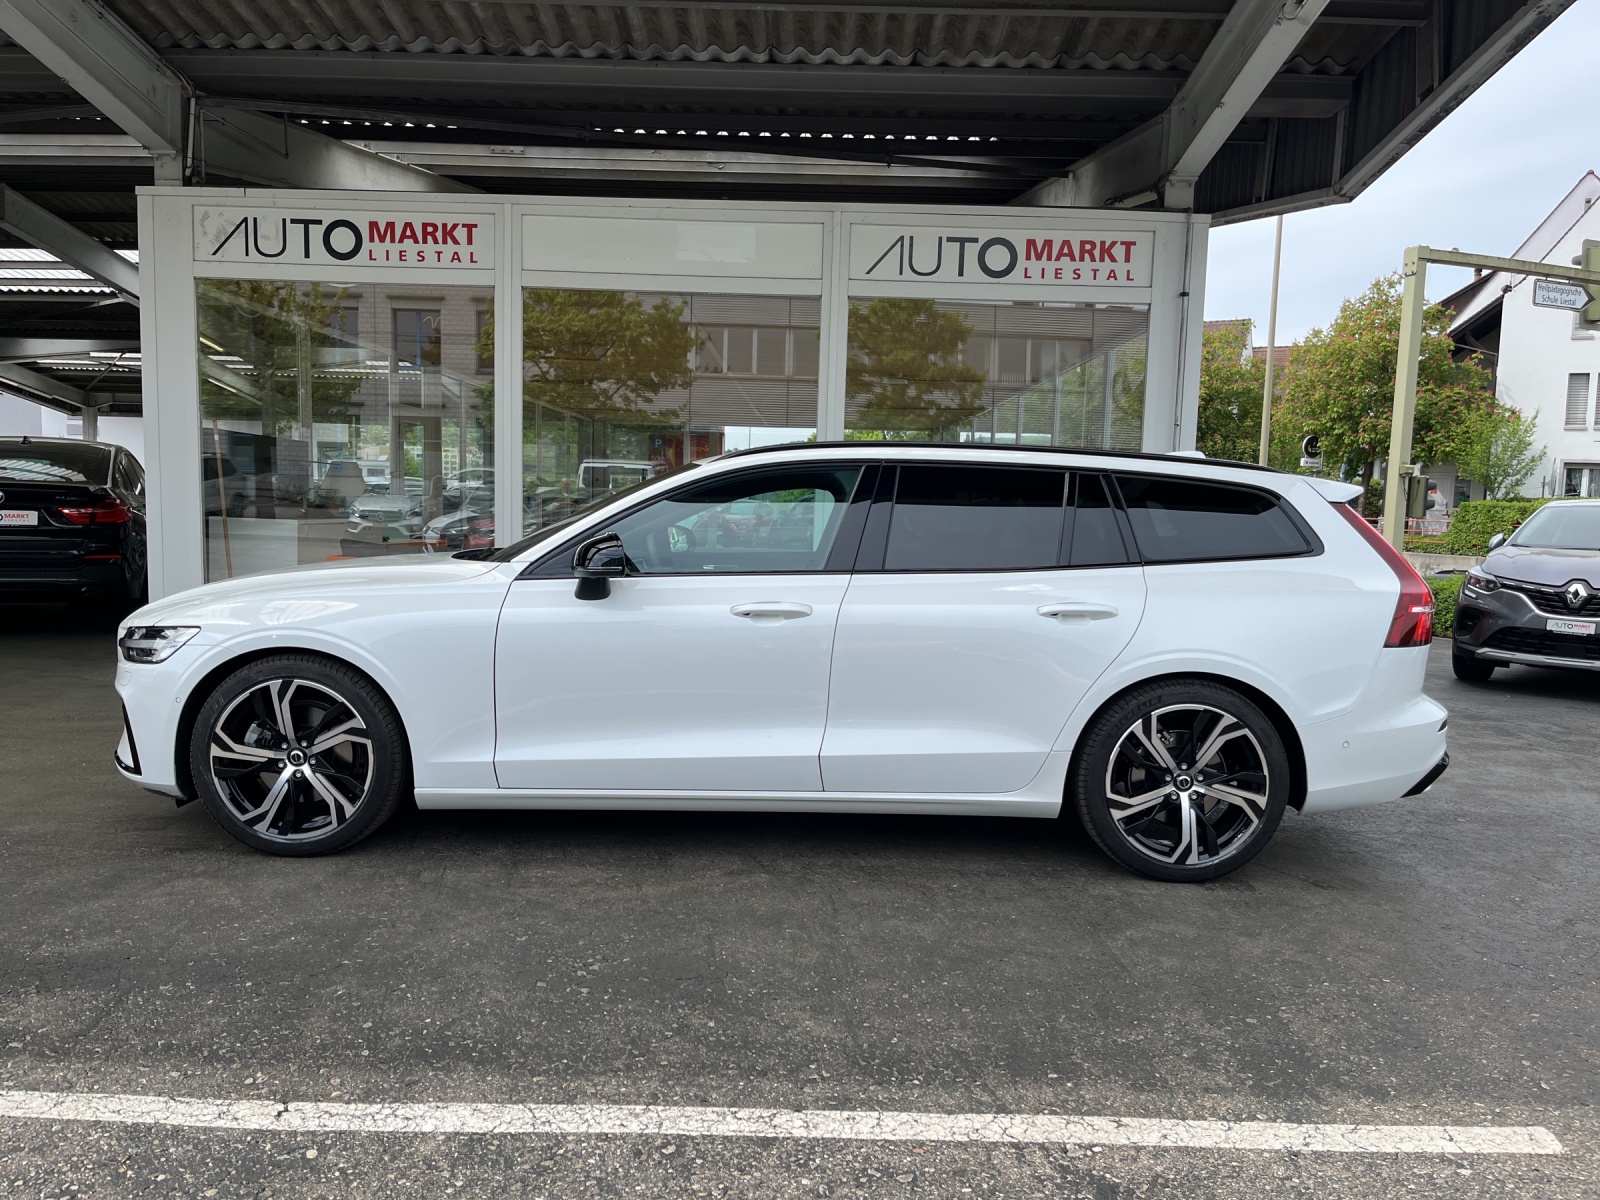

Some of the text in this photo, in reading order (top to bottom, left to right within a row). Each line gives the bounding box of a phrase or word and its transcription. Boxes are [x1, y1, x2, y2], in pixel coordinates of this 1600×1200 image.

[211, 216, 478, 261] AUTO MARKT
[368, 249, 479, 264] LIESTAL
[865, 235, 1137, 279] AUTO MARKT
[1024, 267, 1135, 282] LIESTAL
[1537, 283, 1582, 297] Heilpädagogische
[1541, 294, 1577, 306] Schule Liestal
[1551, 622, 1574, 630] AUTO
